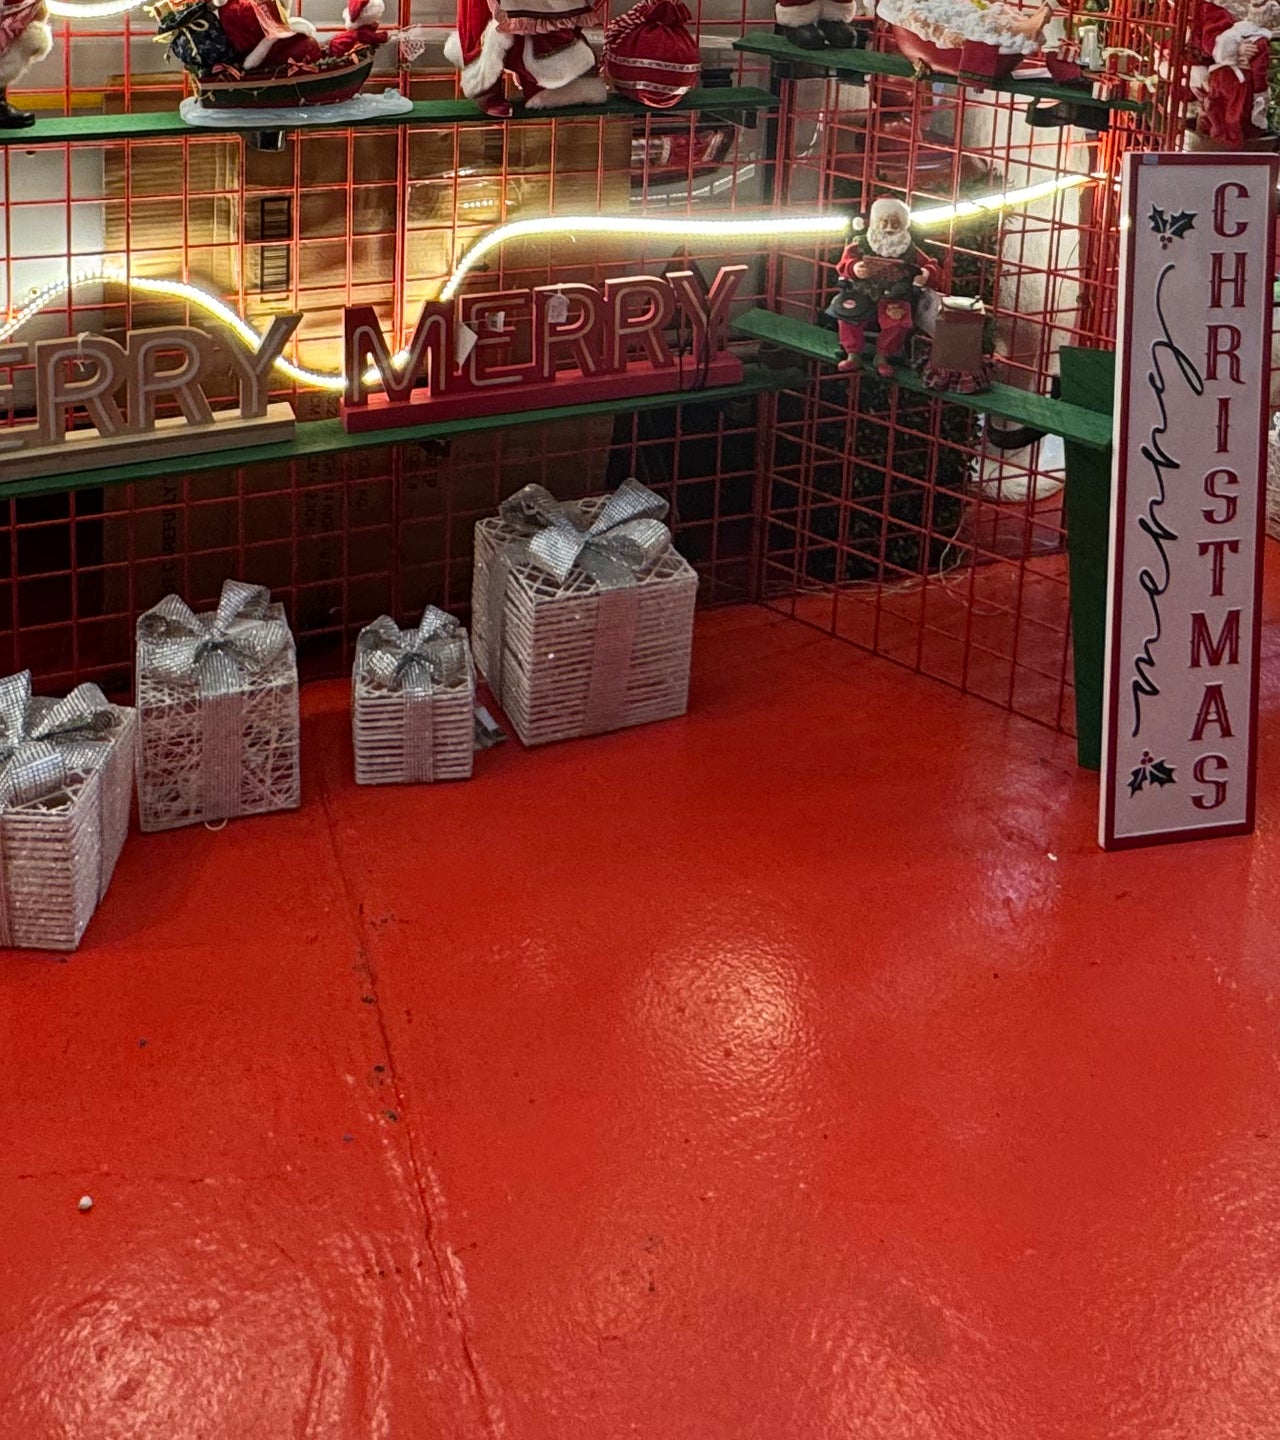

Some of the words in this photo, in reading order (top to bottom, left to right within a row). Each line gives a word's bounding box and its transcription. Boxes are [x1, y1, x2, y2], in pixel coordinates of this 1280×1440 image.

[344, 263, 749, 408] MERRY
[1131, 264, 1204, 738] merry
[1189, 181, 1250, 811] CHRISTMAS
